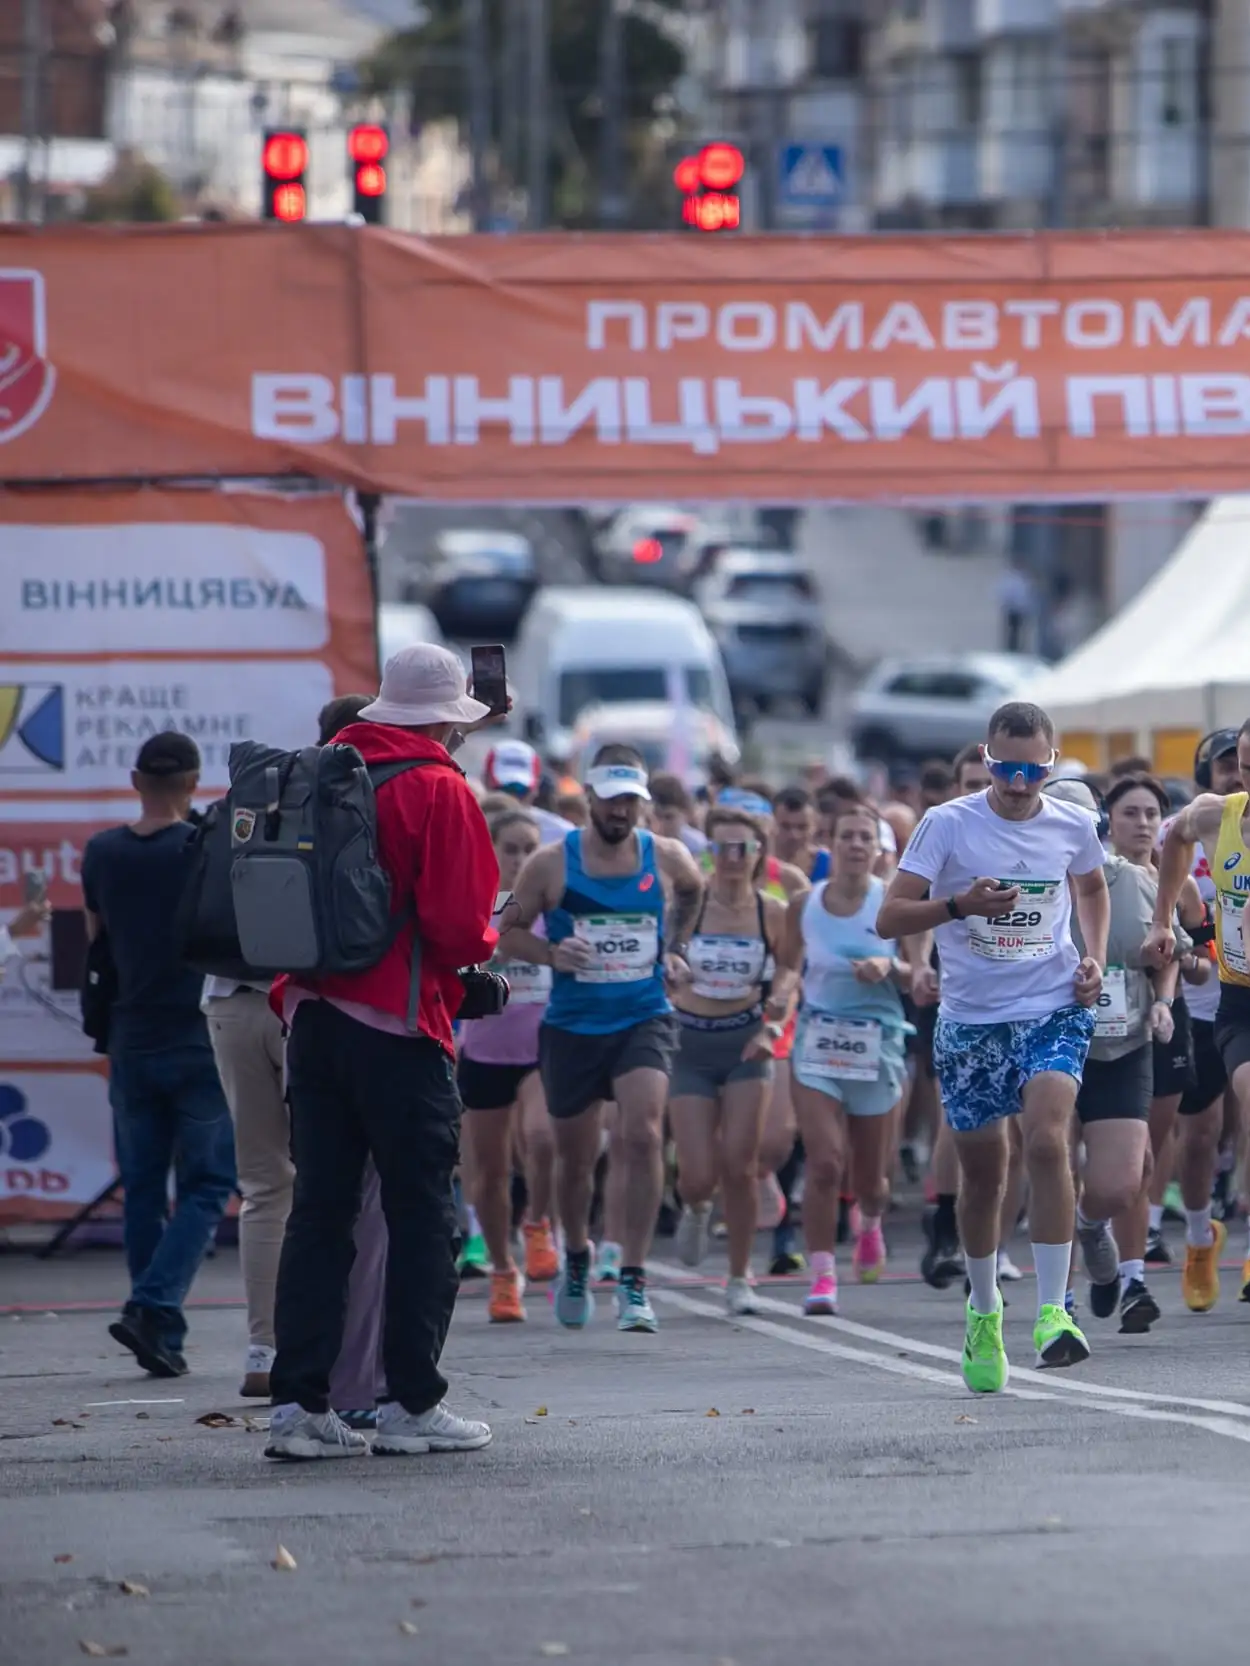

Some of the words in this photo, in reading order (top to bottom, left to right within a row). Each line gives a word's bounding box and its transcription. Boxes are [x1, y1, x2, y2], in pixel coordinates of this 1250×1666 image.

[251, 361, 1039, 454] ВІННИЦЬКИЙ
[21, 577, 308, 611] ВІННИЦЯБУД
[74, 684, 188, 710] КРАЩЕ
[75, 713, 249, 740] РЕКЛАМНЕ
[594, 938, 640, 954] 1012
[997, 936, 1024, 948] RUN
